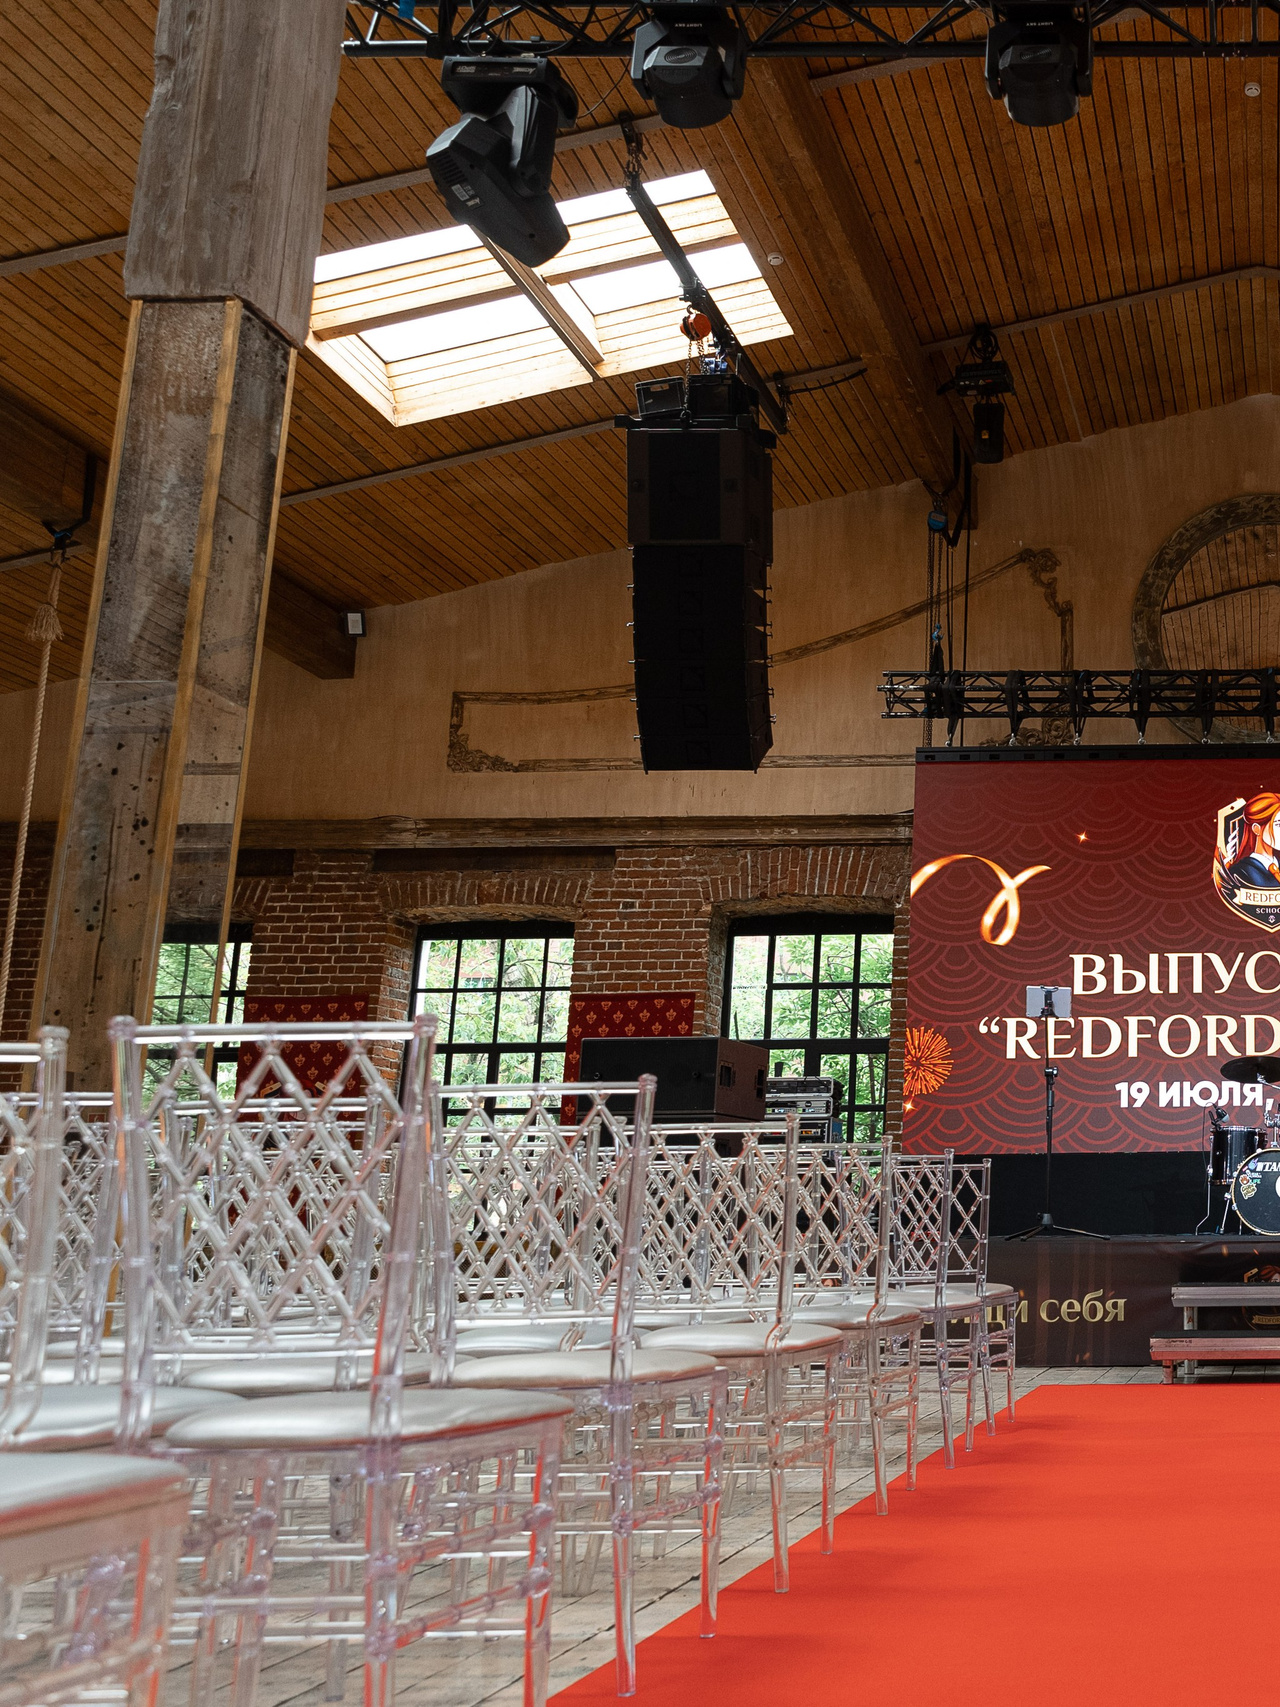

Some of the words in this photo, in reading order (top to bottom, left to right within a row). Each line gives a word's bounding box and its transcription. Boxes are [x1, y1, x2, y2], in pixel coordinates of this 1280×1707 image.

[1114, 1081, 1151, 1108] 19
[1159, 1079, 1275, 1111] ИЮЛЯ,
[1039, 1288, 1127, 1323] себя
